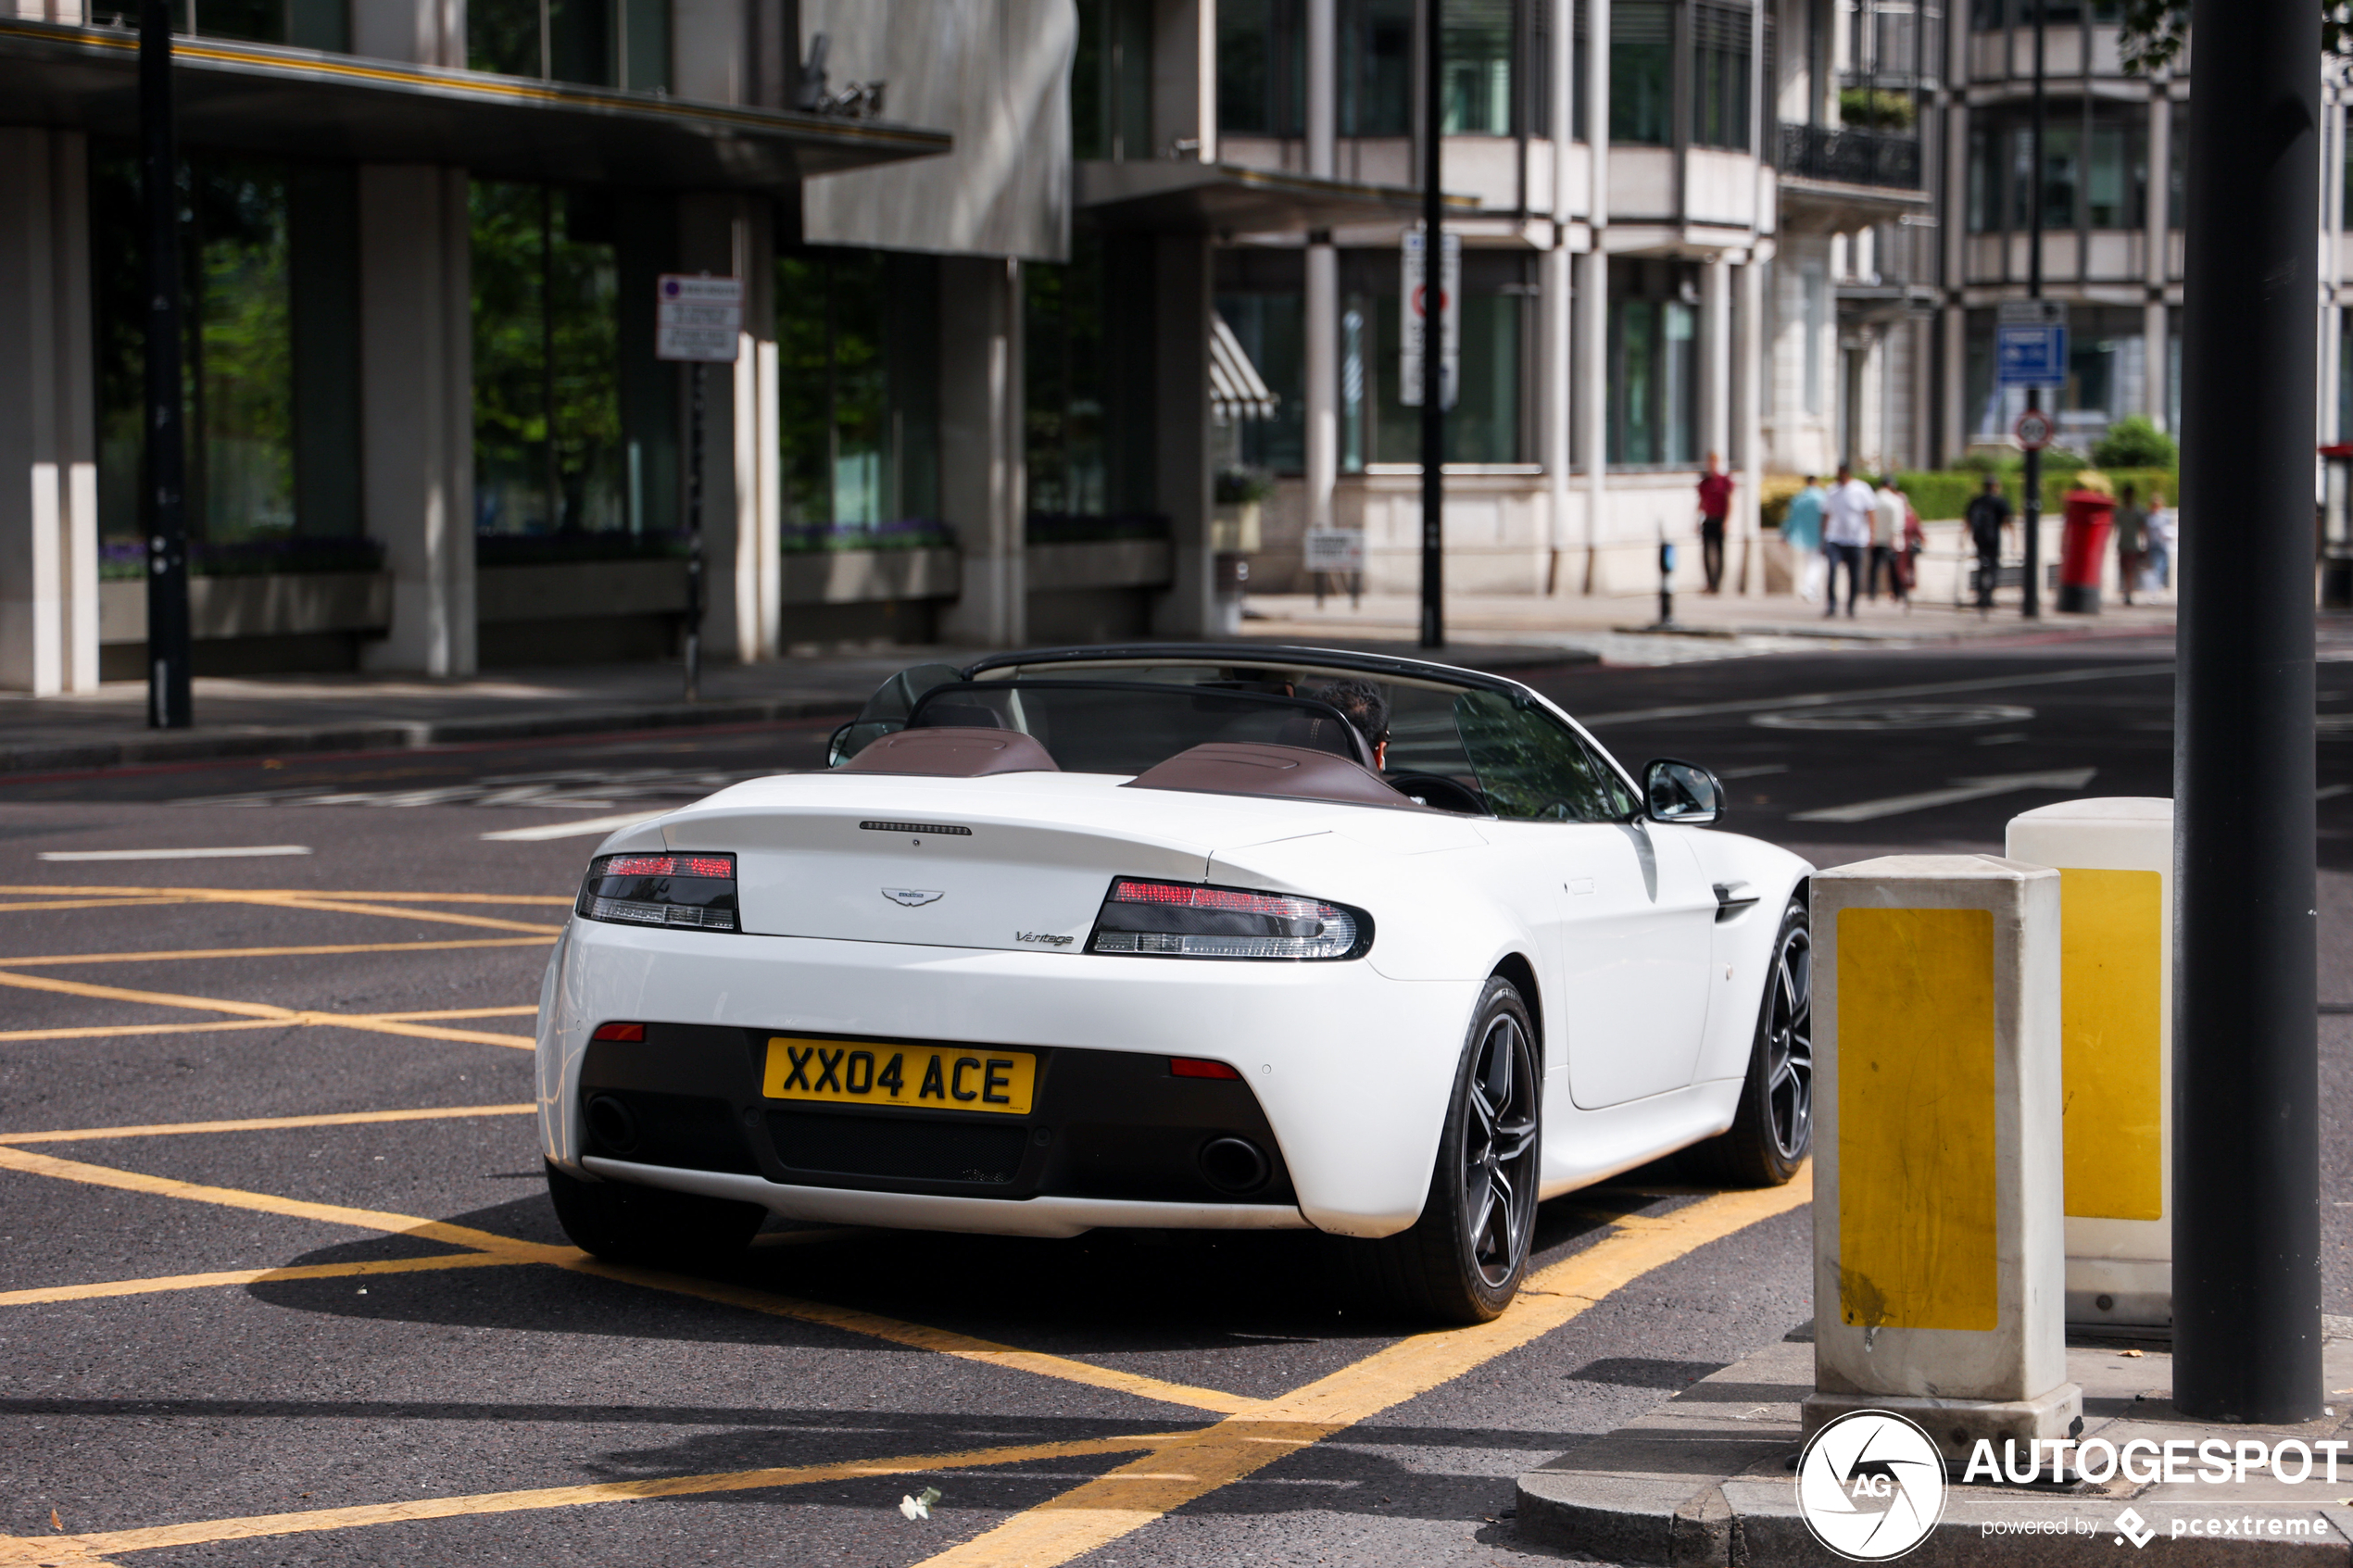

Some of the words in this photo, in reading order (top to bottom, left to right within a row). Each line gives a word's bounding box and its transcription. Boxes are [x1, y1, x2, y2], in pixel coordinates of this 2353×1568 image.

[1015, 931, 1075, 947] Vantage
[783, 1046, 904, 1097] XX04
[918, 1055, 1013, 1104] ACE
